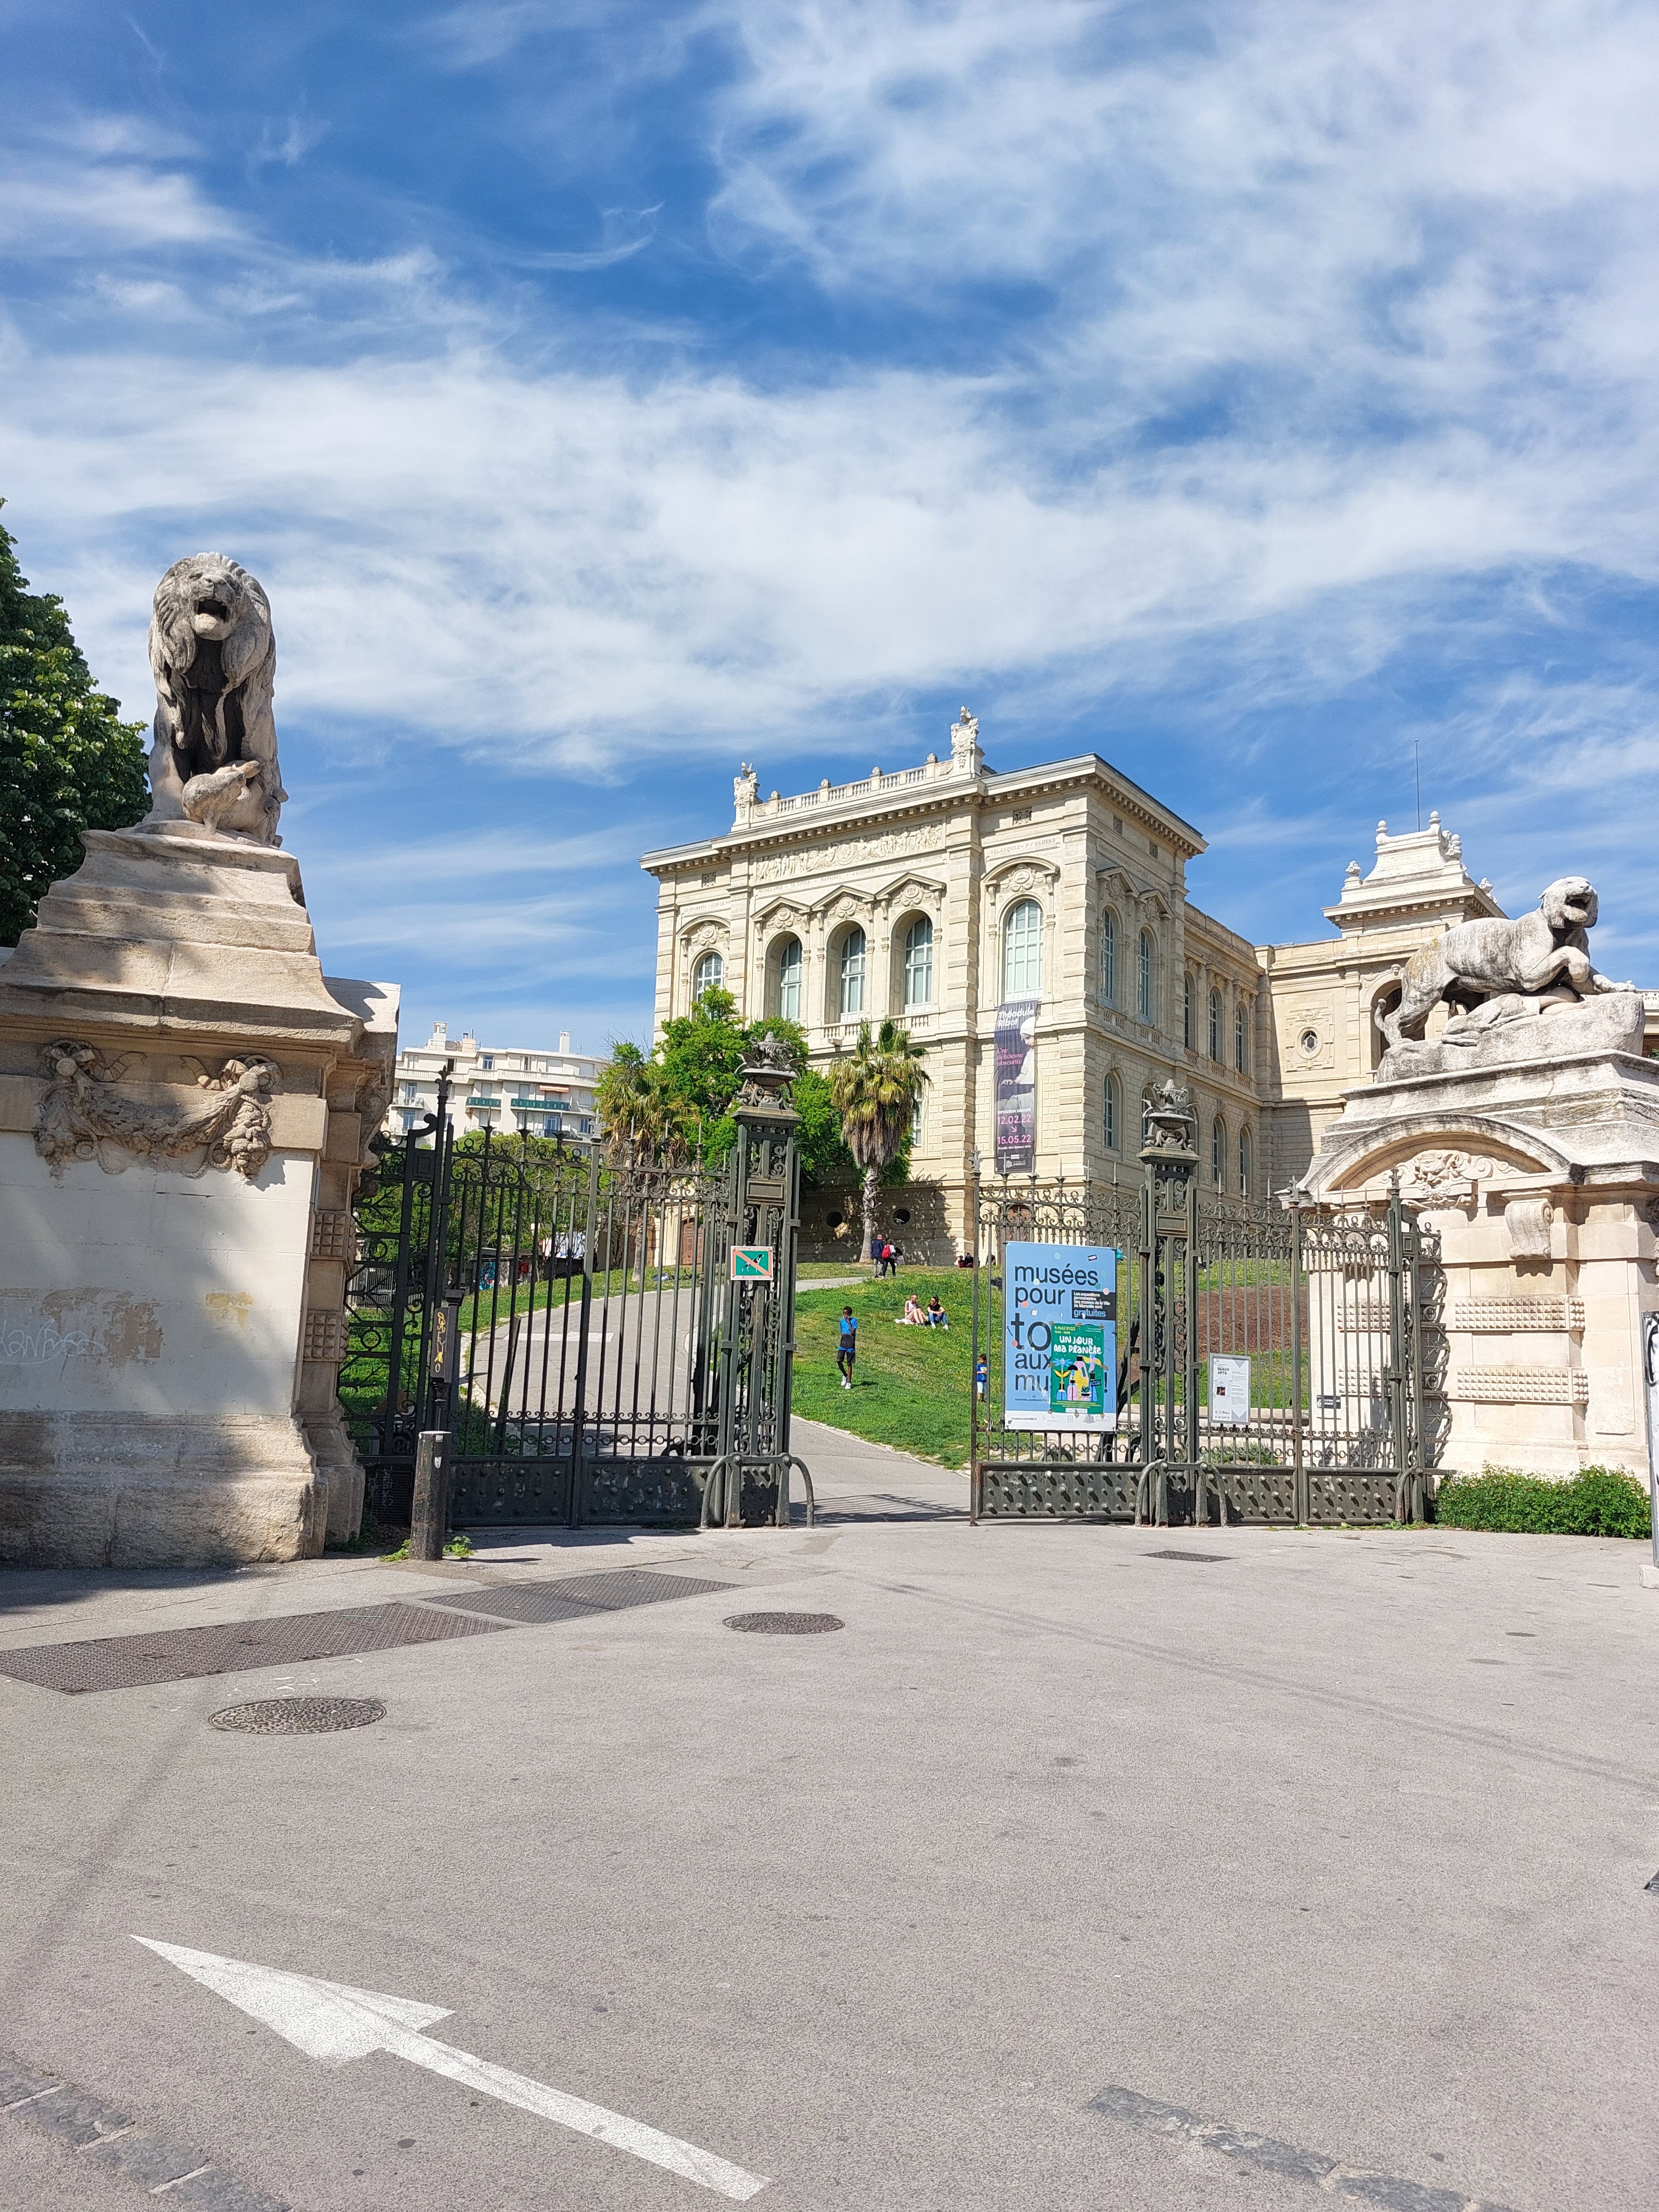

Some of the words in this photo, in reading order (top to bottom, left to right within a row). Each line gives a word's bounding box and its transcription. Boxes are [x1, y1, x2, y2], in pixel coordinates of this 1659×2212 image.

[998, 1006, 1035, 1019] Théodule
[998, 1018, 1018, 1027] Ribot
[998, 1114, 1031, 1125] 12.02.22
[997, 1134, 1031, 1145] 15.05.22
[1015, 1263, 1099, 1286] musées
[1015, 1287, 1066, 1308] pour
[1073, 1309, 1106, 1317] gratuites
[1010, 1313, 1051, 1351] to
[1073, 1336, 1094, 1345] JOUR
[1015, 1353, 1052, 1370] aux
